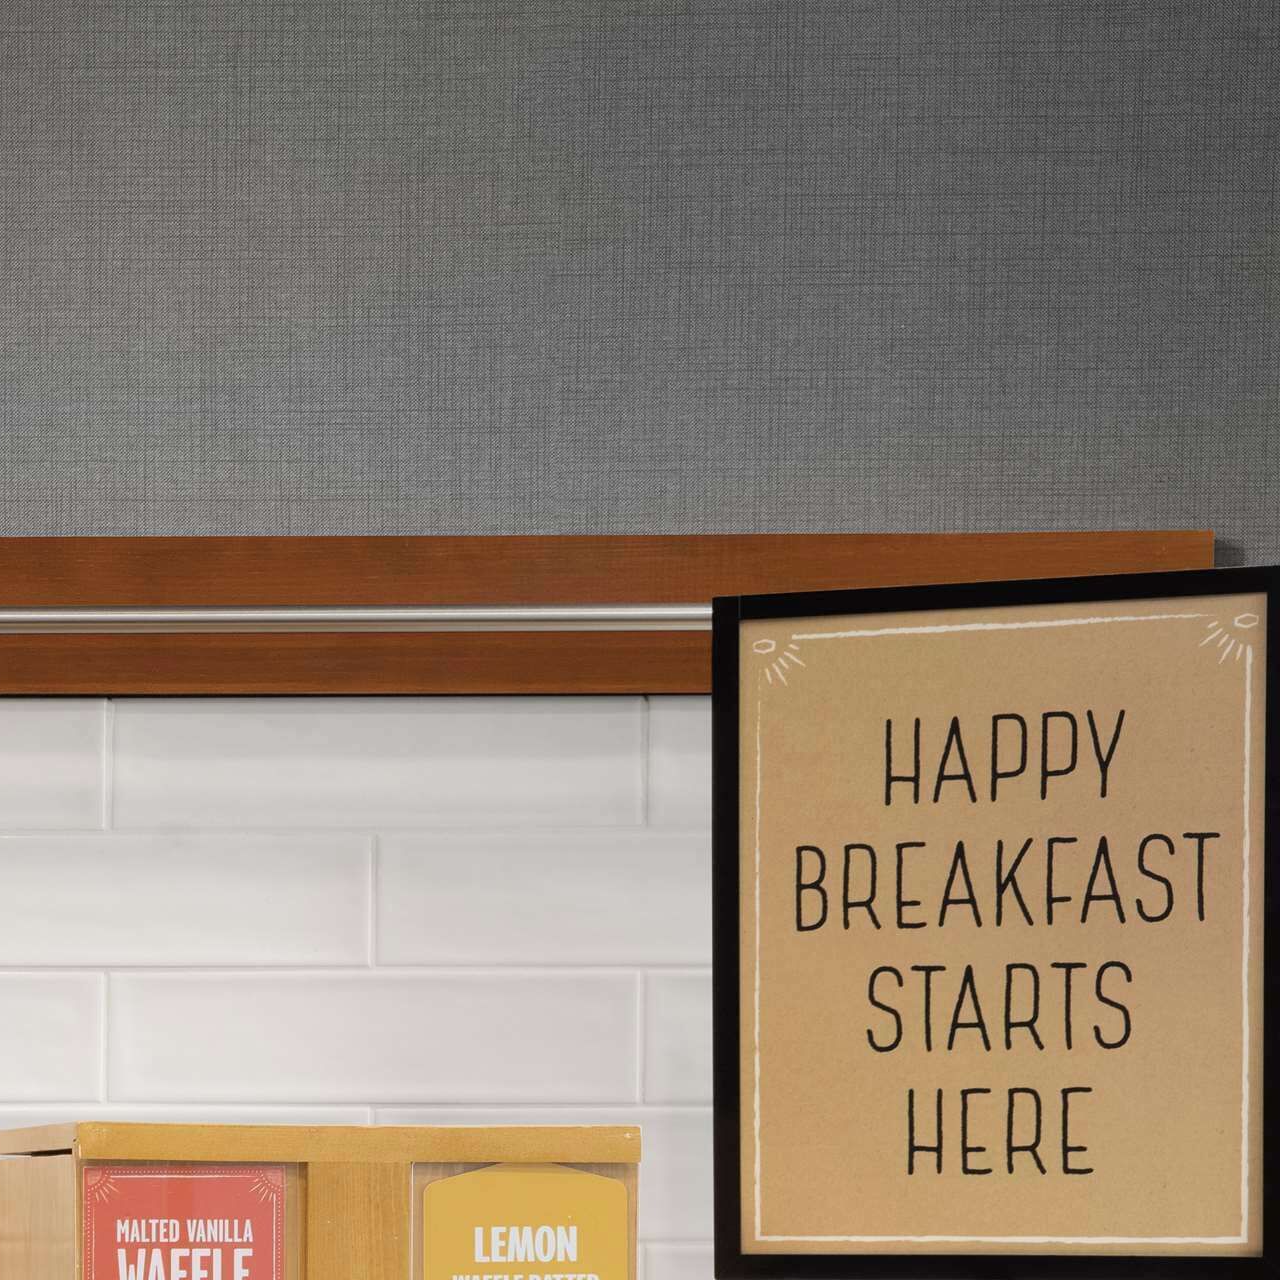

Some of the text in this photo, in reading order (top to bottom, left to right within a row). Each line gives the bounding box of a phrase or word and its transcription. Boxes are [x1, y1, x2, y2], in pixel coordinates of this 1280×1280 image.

[884, 709, 1126, 806] HAPPY
[795, 831, 1221, 932] BREAKFAST
[866, 960, 1133, 1052] STARTS
[908, 1086, 1095, 1175] HERE
[116, 1218, 253, 1243] MALTED VANILLA
[474, 1226, 577, 1263] LEMON
